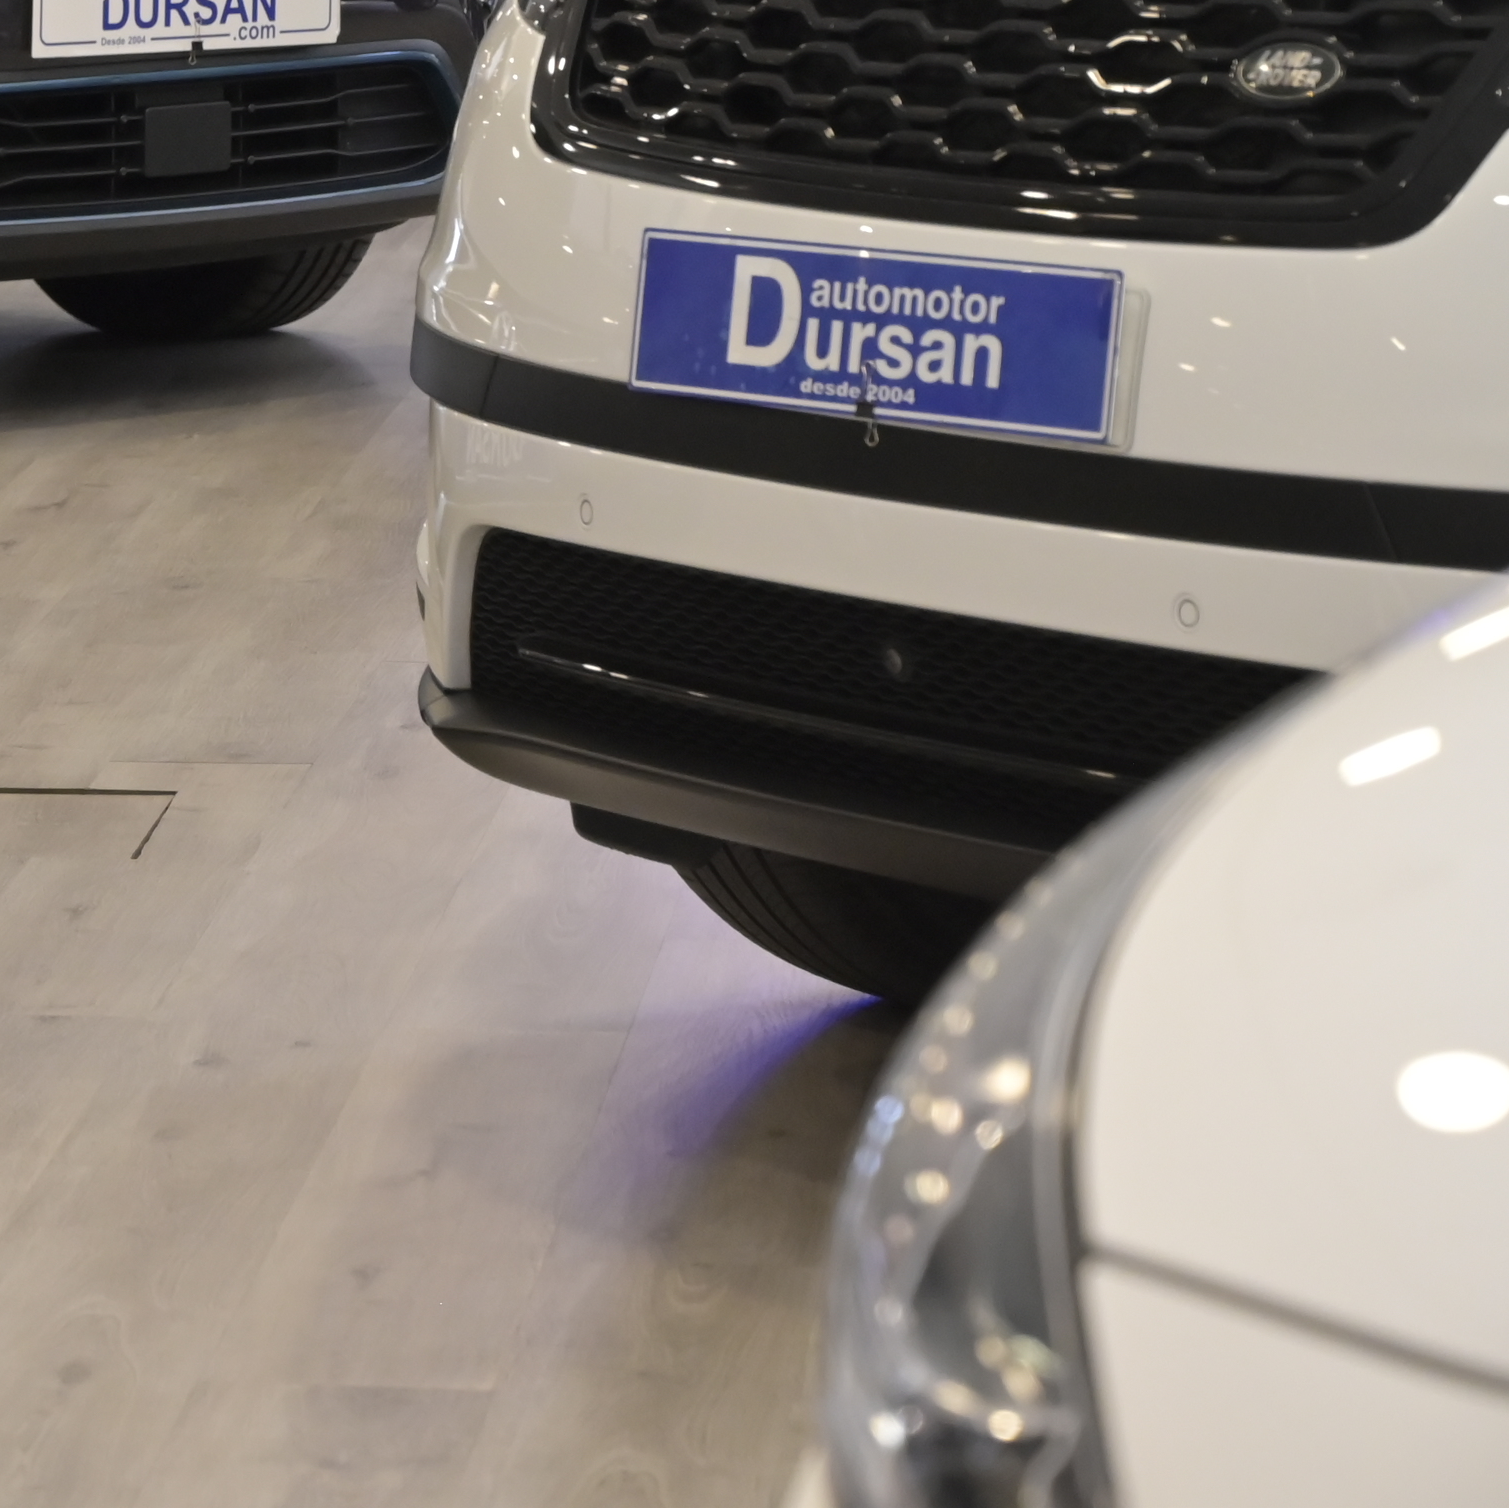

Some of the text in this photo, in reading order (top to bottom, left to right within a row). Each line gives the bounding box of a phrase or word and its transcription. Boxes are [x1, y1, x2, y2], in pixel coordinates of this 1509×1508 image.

[101, 34, 147, 46] Desde 2004
[233, 23, 277, 42] .com
[809, 277, 1005, 325] automotor
[799, 377, 916, 405] desde 2004
